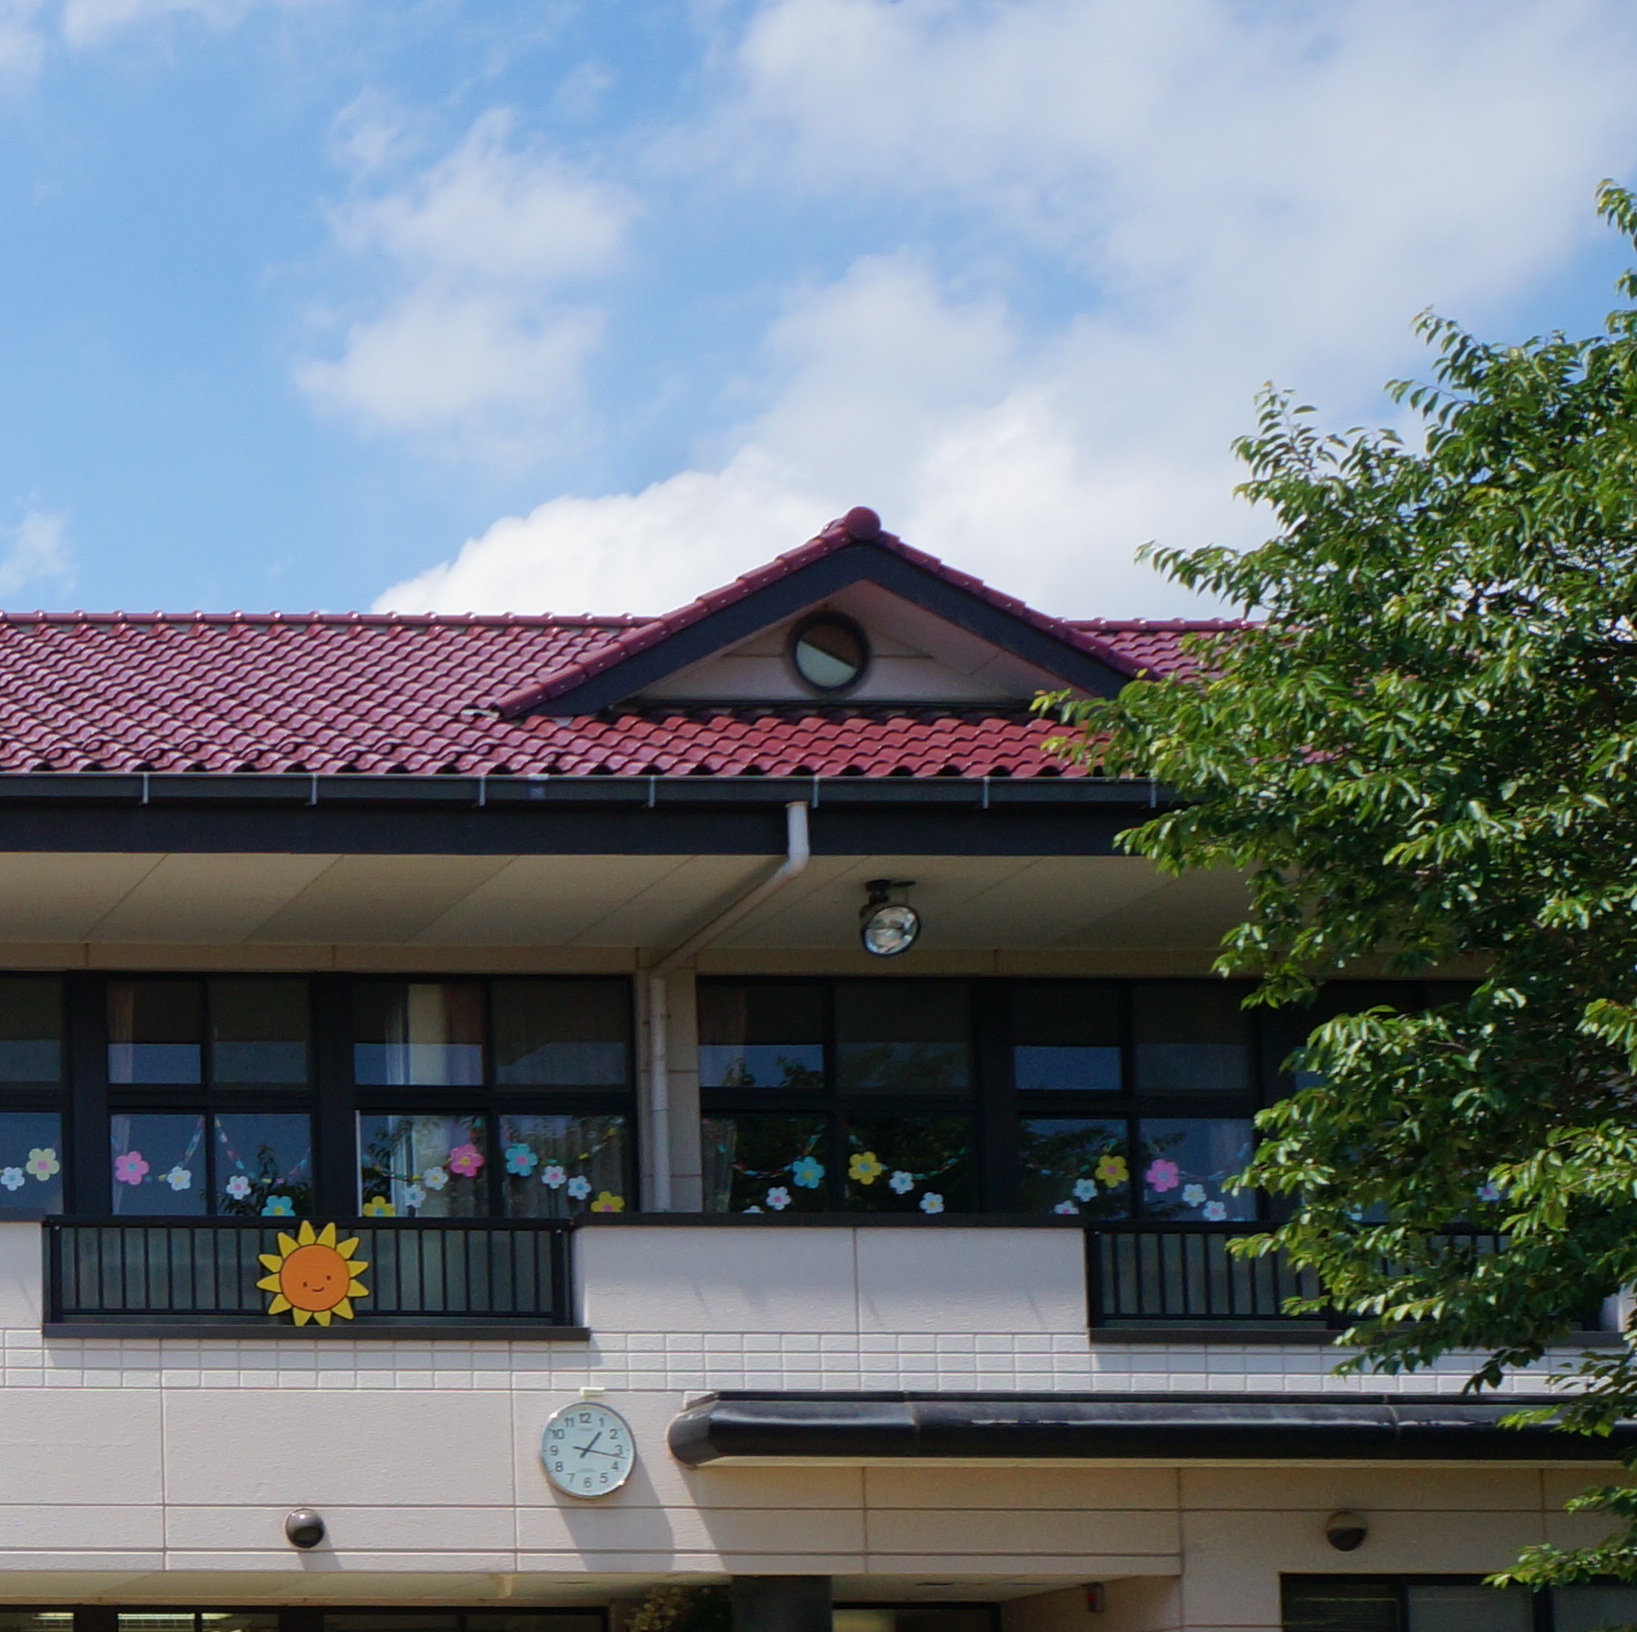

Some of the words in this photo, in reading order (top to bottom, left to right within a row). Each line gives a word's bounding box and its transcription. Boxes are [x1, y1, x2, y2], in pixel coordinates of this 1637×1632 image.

[564, 1417, 575, 1428] 11
[579, 1412, 592, 1424] 12
[599, 1417, 605, 1427] 1
[551, 1428, 565, 1440] 10
[609, 1428, 619, 1440] 2
[550, 1445, 559, 1456] 9
[614, 1444, 623, 1456] 3
[555, 1461, 564, 1472] 8
[611, 1461, 619, 1471] 4
[567, 1473, 576, 1484] 7
[584, 1477, 592, 1488] 6
[600, 1472, 608, 1484] 5
